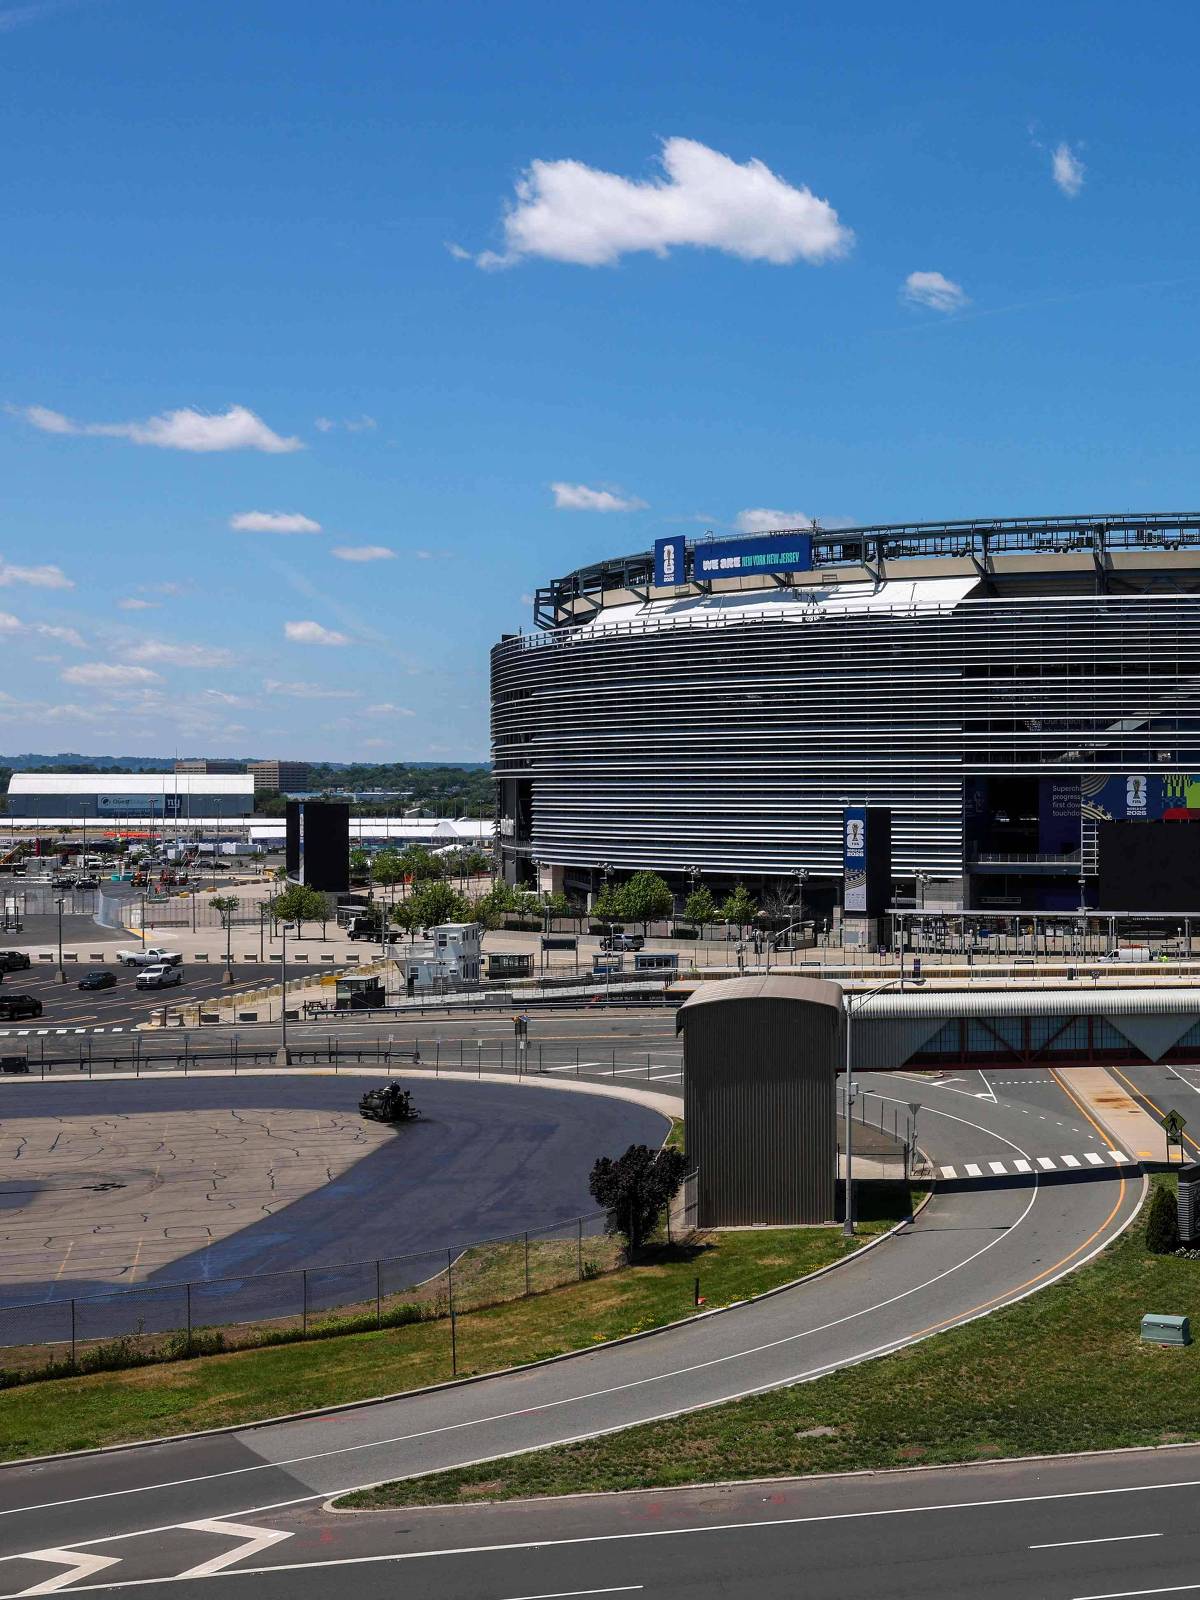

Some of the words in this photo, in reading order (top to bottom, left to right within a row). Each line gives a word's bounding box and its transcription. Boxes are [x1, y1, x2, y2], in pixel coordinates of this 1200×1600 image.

[703, 559, 719, 571] WE
[720, 557, 741, 569] ARE
[742, 555, 753, 567] NEW
[753, 554, 766, 566] YORK
[767, 553, 779, 565] NEW
[780, 552, 799, 564] JERSEY
